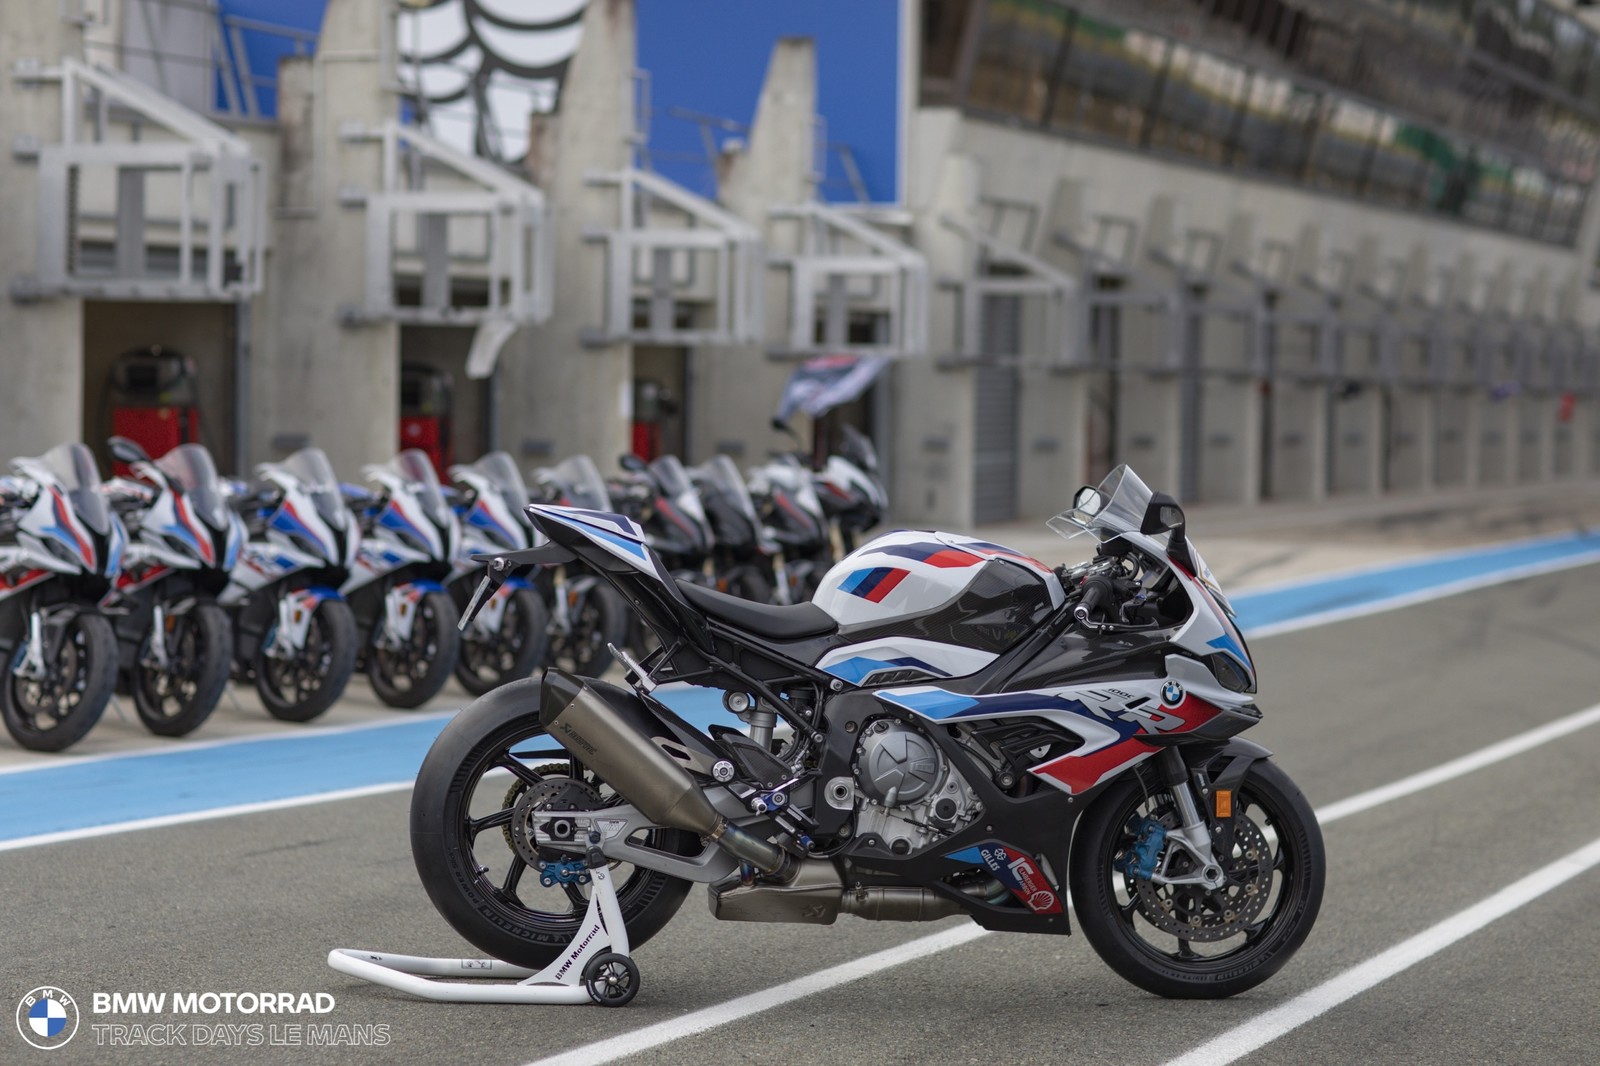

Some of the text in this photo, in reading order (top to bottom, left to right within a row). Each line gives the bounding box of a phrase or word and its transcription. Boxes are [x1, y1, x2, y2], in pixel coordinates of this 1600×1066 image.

[981, 849, 1000, 871] GILLES
[455, 871, 480, 905] POWER
[482, 906, 550, 941] MICHELIN
[555, 959, 573, 980] BMW
[571, 924, 600, 960] Motorrad
